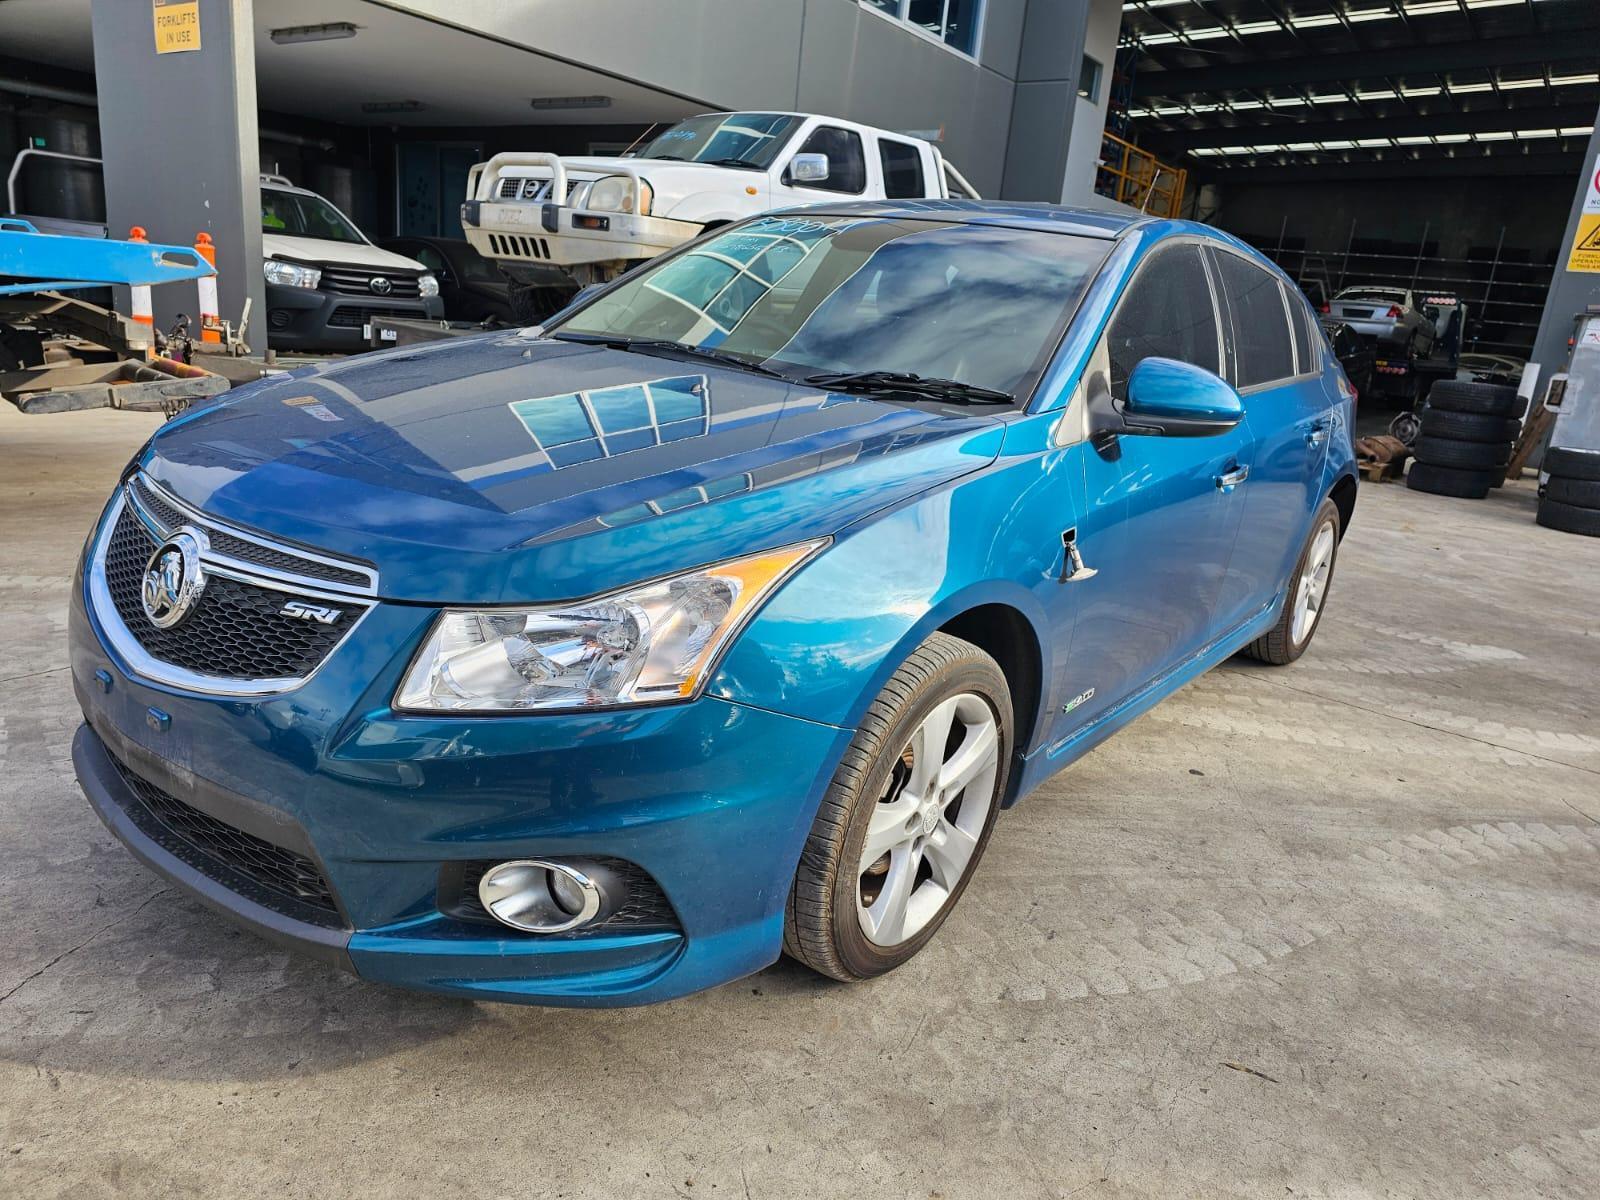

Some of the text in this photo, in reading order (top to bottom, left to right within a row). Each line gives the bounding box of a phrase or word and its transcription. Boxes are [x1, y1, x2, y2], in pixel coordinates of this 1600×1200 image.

[157, 12, 196, 28] FORKLIFTS
[166, 30, 191, 45] IN USE
